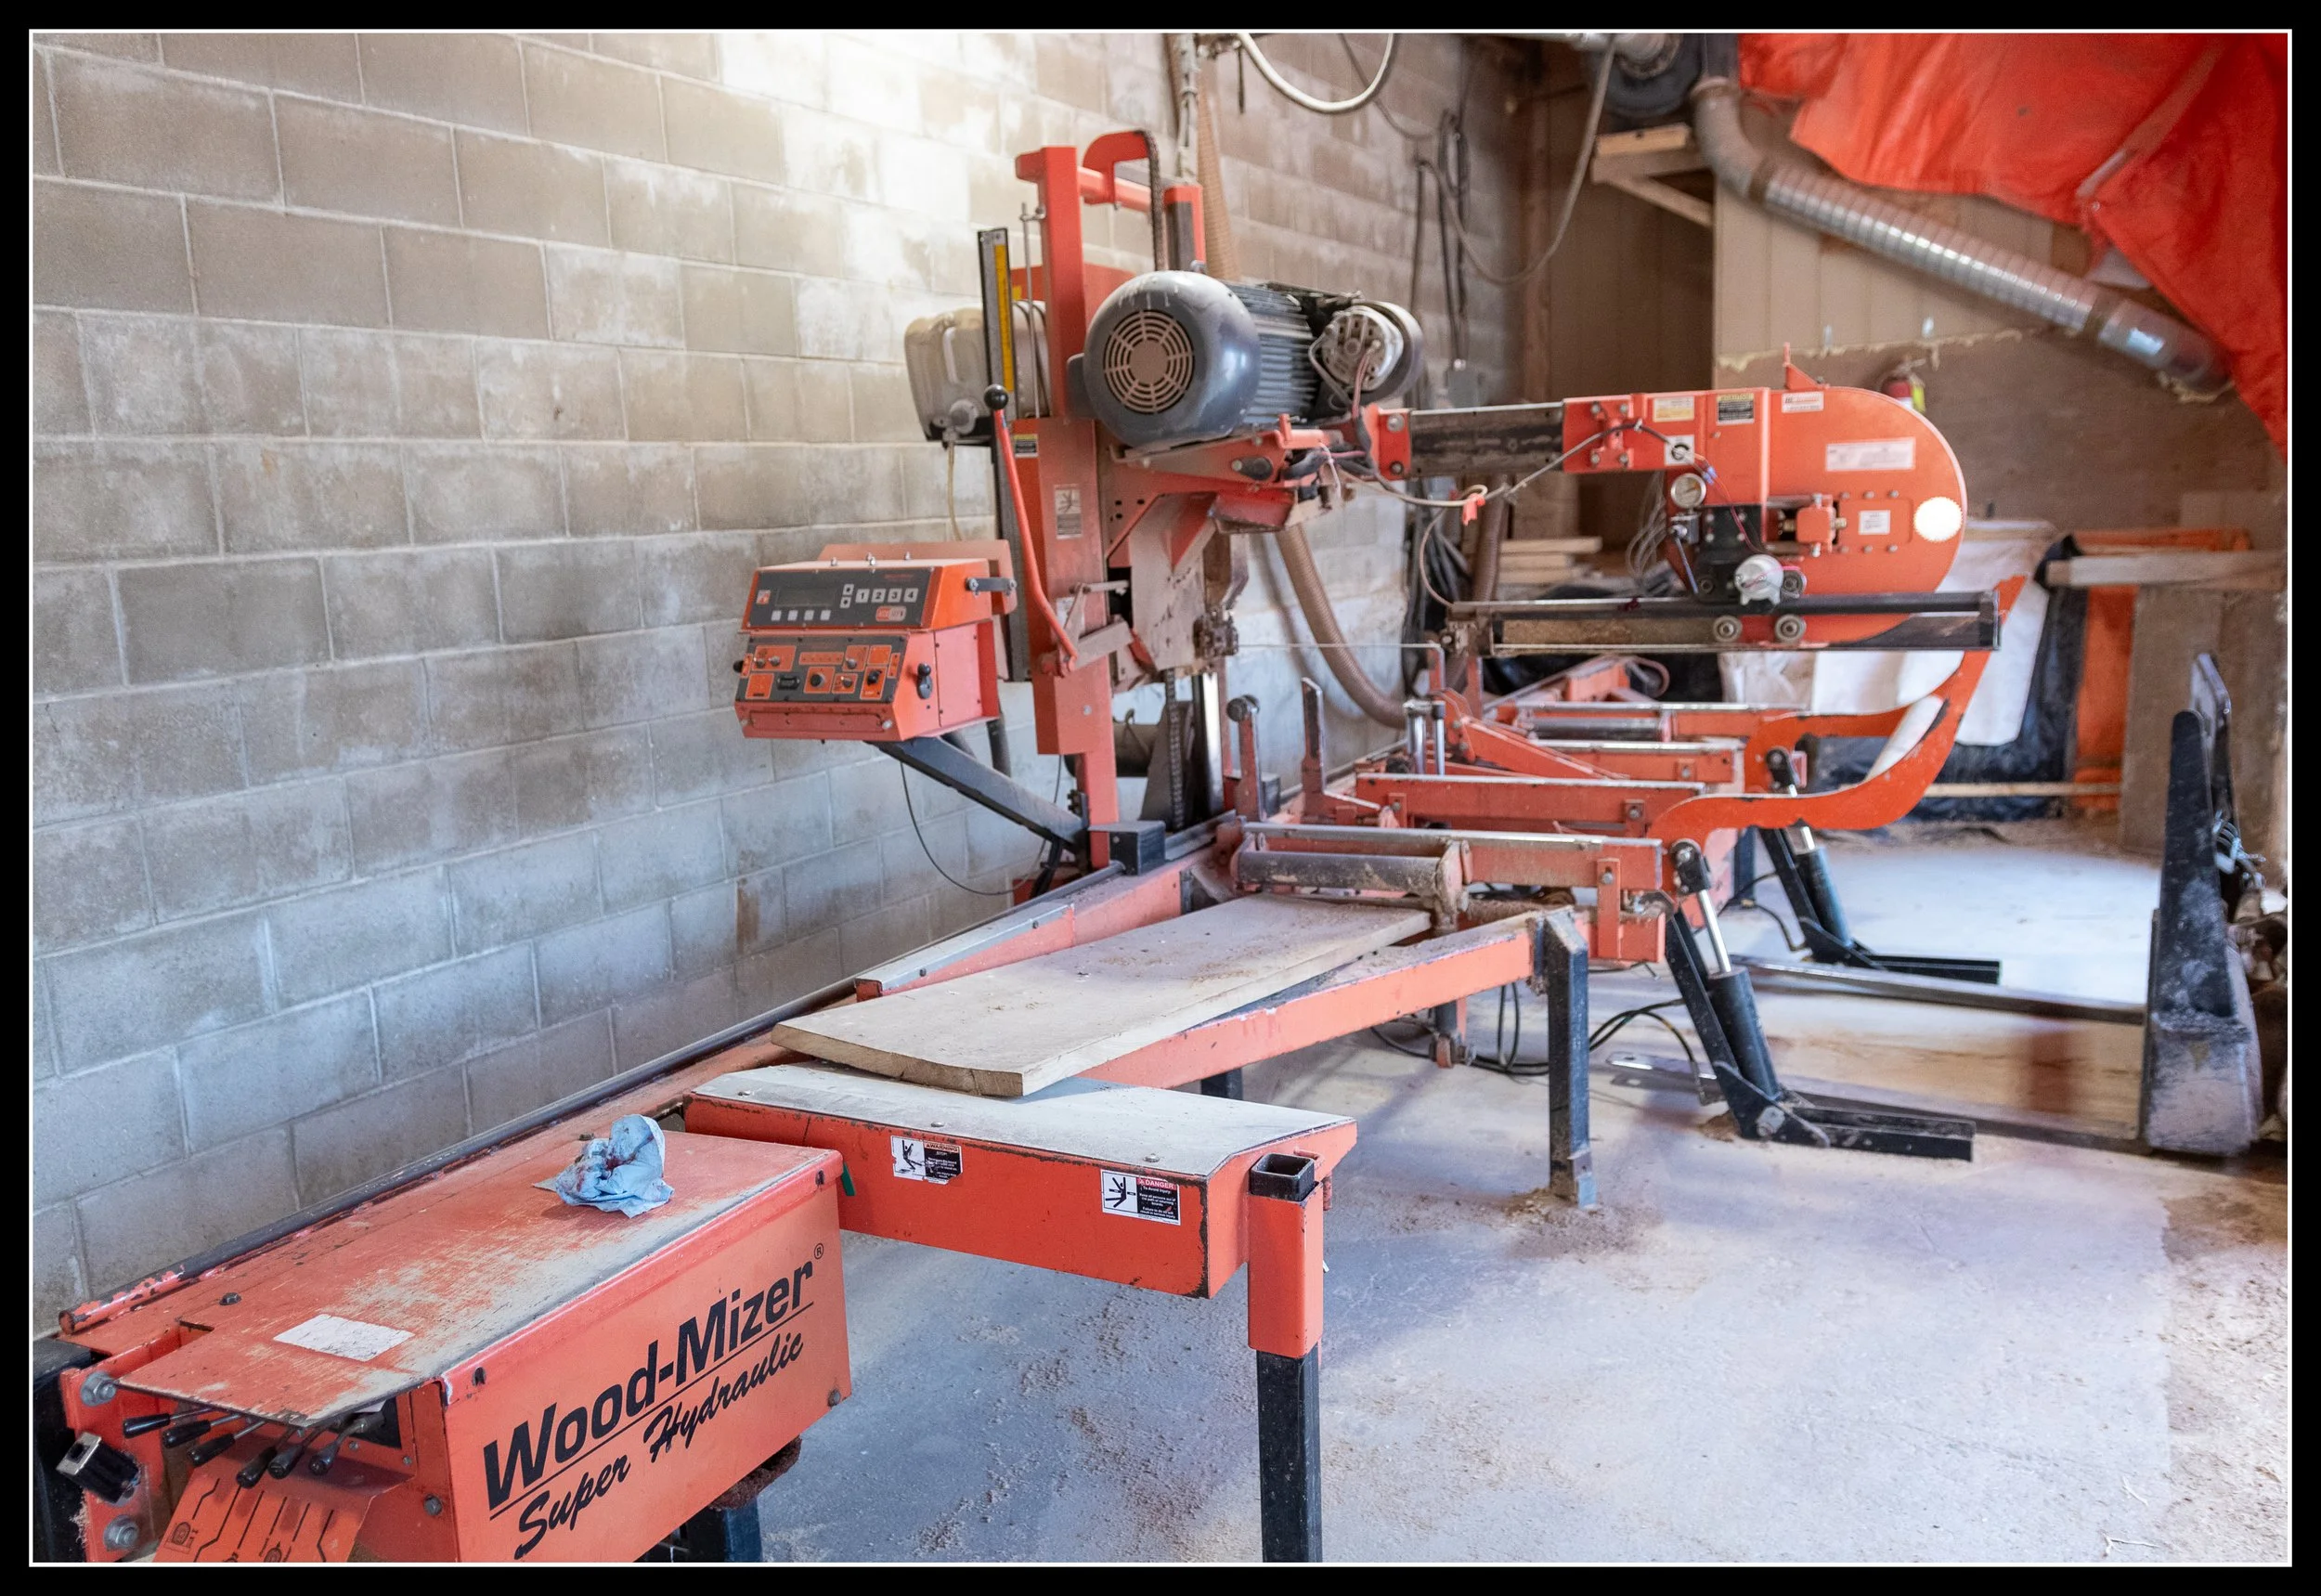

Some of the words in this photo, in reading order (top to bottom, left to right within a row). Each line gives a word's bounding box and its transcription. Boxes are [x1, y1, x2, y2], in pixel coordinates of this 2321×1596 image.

[930, 1143, 958, 1152] WARNING
[1145, 1179, 1174, 1188] DANGER
[483, 1260, 813, 1511] Wood-Mizer
[514, 1454, 630, 1560] Super
[642, 1332, 804, 1462] Hydraulic
